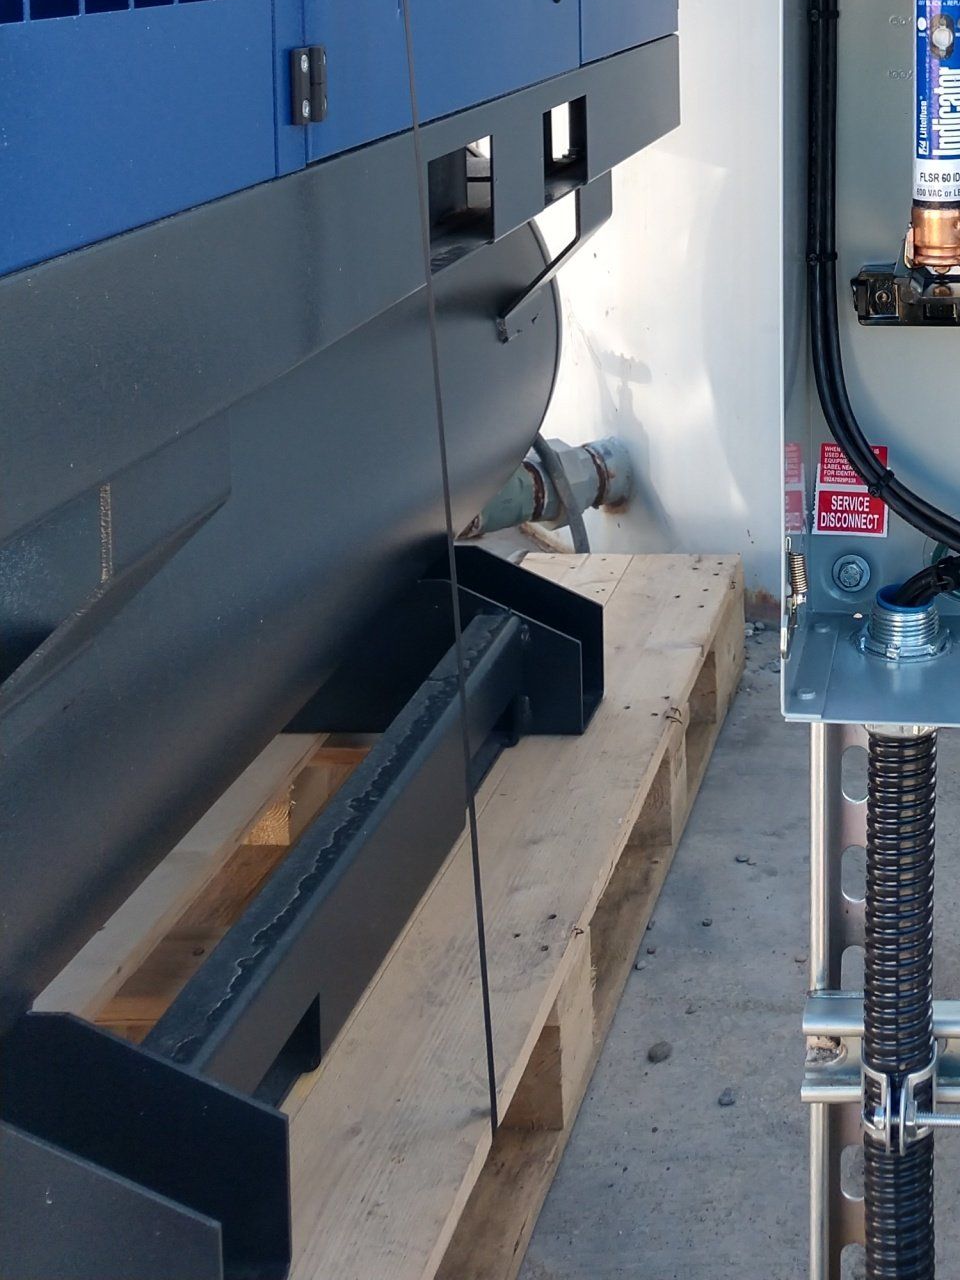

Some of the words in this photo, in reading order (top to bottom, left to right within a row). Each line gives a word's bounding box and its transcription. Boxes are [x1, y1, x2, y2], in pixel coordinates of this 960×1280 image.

[919, 100, 927, 138] Littelfuse
[920, 172, 939, 182] FLSR
[942, 172, 951, 183] 60
[953, 172, 960, 183] ID
[928, 188, 942, 197] VAC
[831, 496, 870, 512] SERVICE
[820, 512, 879, 529] DISCONNECT
